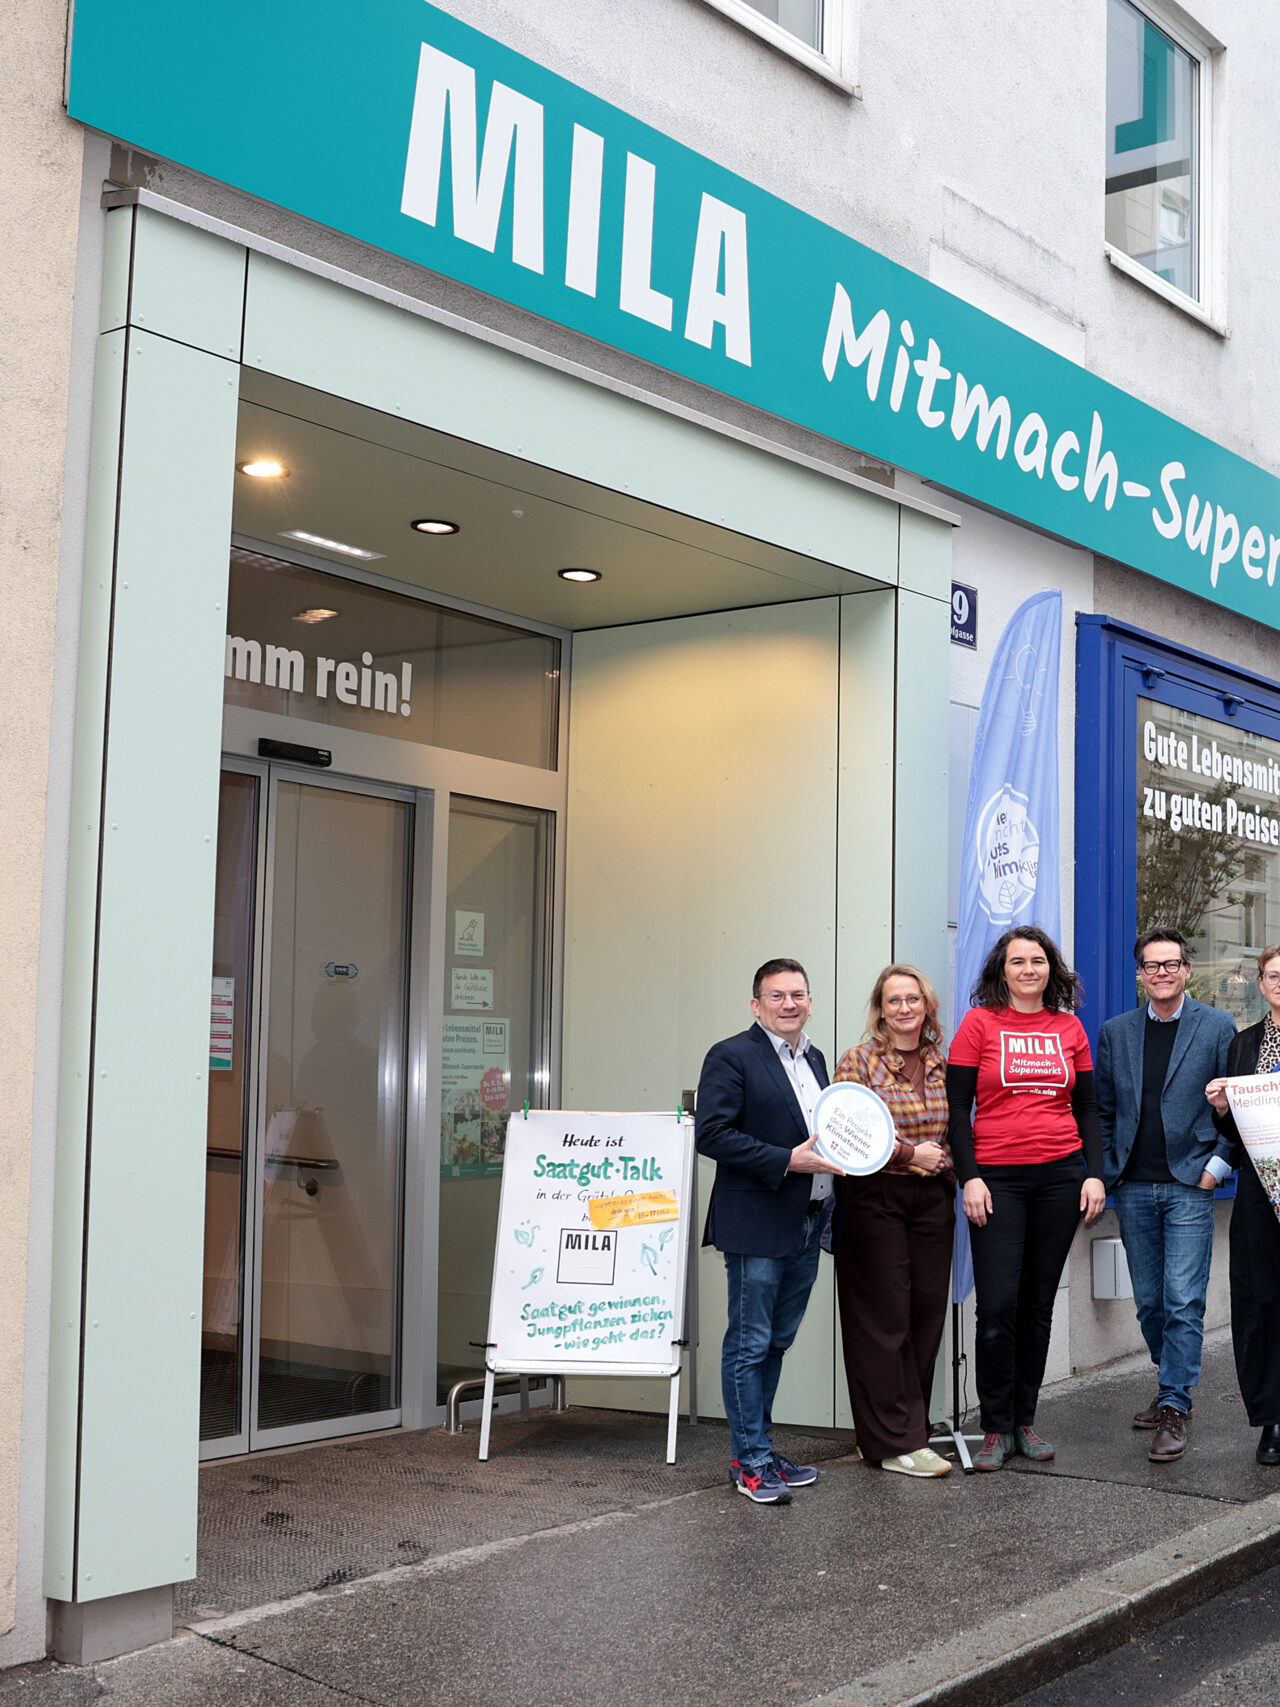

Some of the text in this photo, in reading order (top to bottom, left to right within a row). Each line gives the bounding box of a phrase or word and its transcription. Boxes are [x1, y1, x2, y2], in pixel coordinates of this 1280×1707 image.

[400, 41, 752, 368] MILA
[316, 651, 413, 717] rein!
[1143, 720, 1188, 770] Gute
[1143, 787, 1166, 820] zu
[1170, 792, 1223, 833] guten
[485, 1026, 504, 1035] MILA
[1008, 1037, 1056, 1055] MILA
[1008, 1066, 1062, 1076] Supermarkt
[1012, 1058, 1055, 1067] Mitmach-
[562, 1133, 627, 1148] Heute ist
[844, 1126, 872, 1150] Wiener
[846, 1117, 873, 1140] Projekt
[825, 1122, 870, 1160] Klimateams
[536, 1188, 547, 1200] in
[551, 1189, 572, 1200] der
[565, 1234, 611, 1251] MILA
[520, 1295, 666, 1321] Saatgut gewinnen,
[526, 1309, 674, 1340] Jungpflanzen ziehen
[591, 1331, 627, 1351] geht
[629, 1322, 666, 1342] das?
